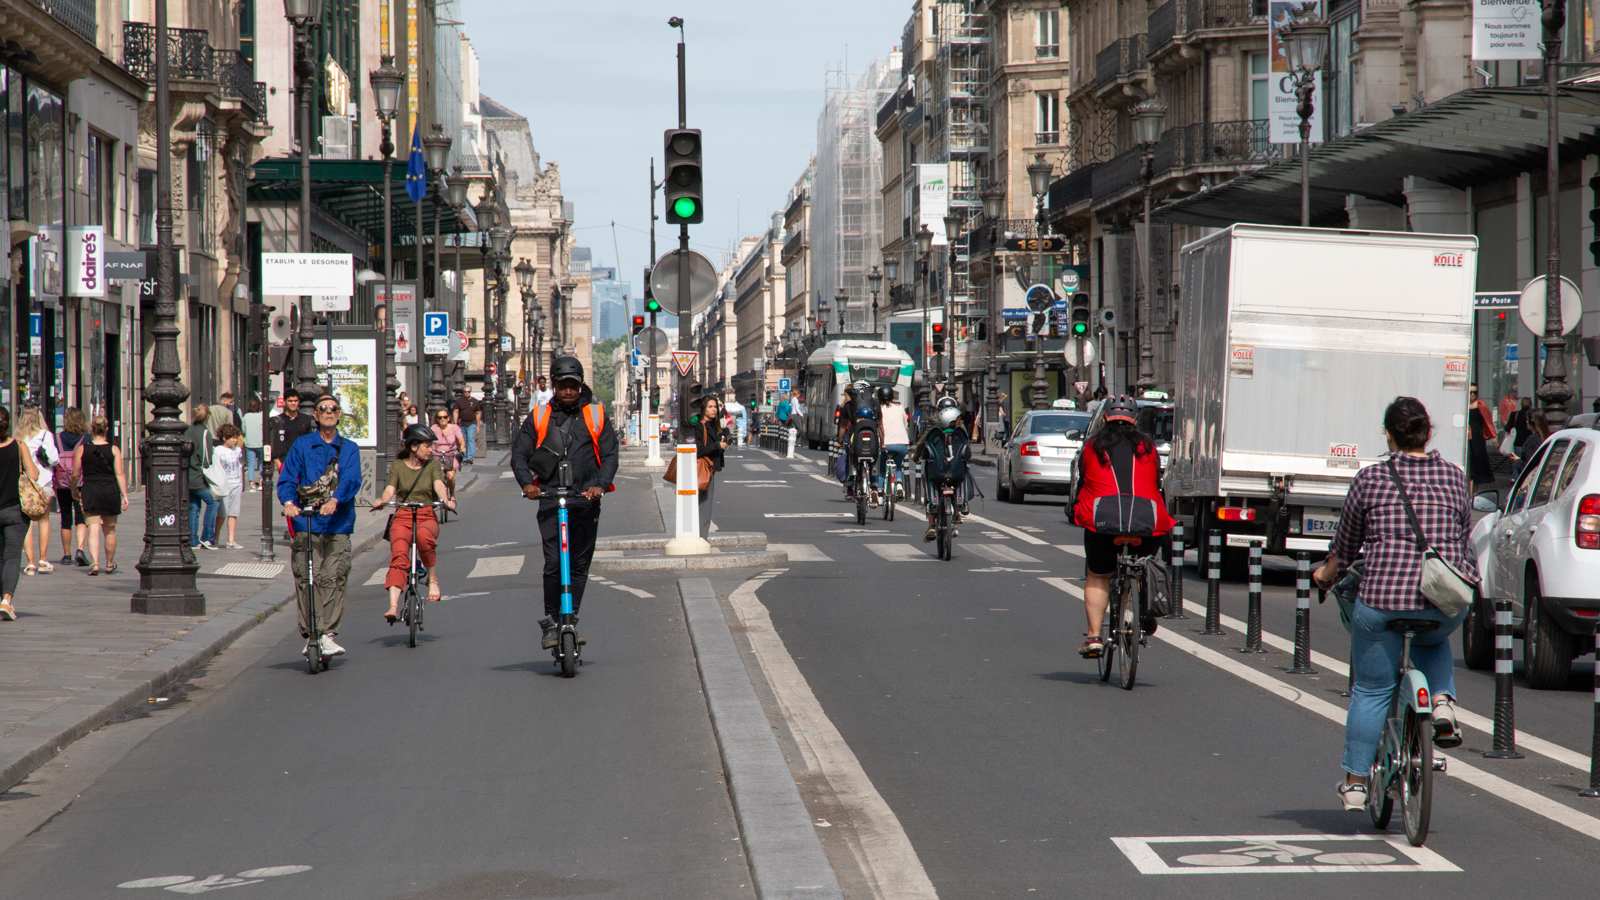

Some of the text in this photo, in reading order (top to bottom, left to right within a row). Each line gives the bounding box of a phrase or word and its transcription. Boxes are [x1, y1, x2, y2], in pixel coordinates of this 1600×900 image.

[82, 233, 96, 290] claire's
[1434, 254, 1463, 266] KOLLÉ
[1063, 274, 1077, 282] BUS
[430, 317, 442, 333] P
[1232, 350, 1253, 360] KOLLÉ
[1446, 362, 1466, 371] KOLLÉ
[1330, 446, 1357, 457] KOLLÉ
